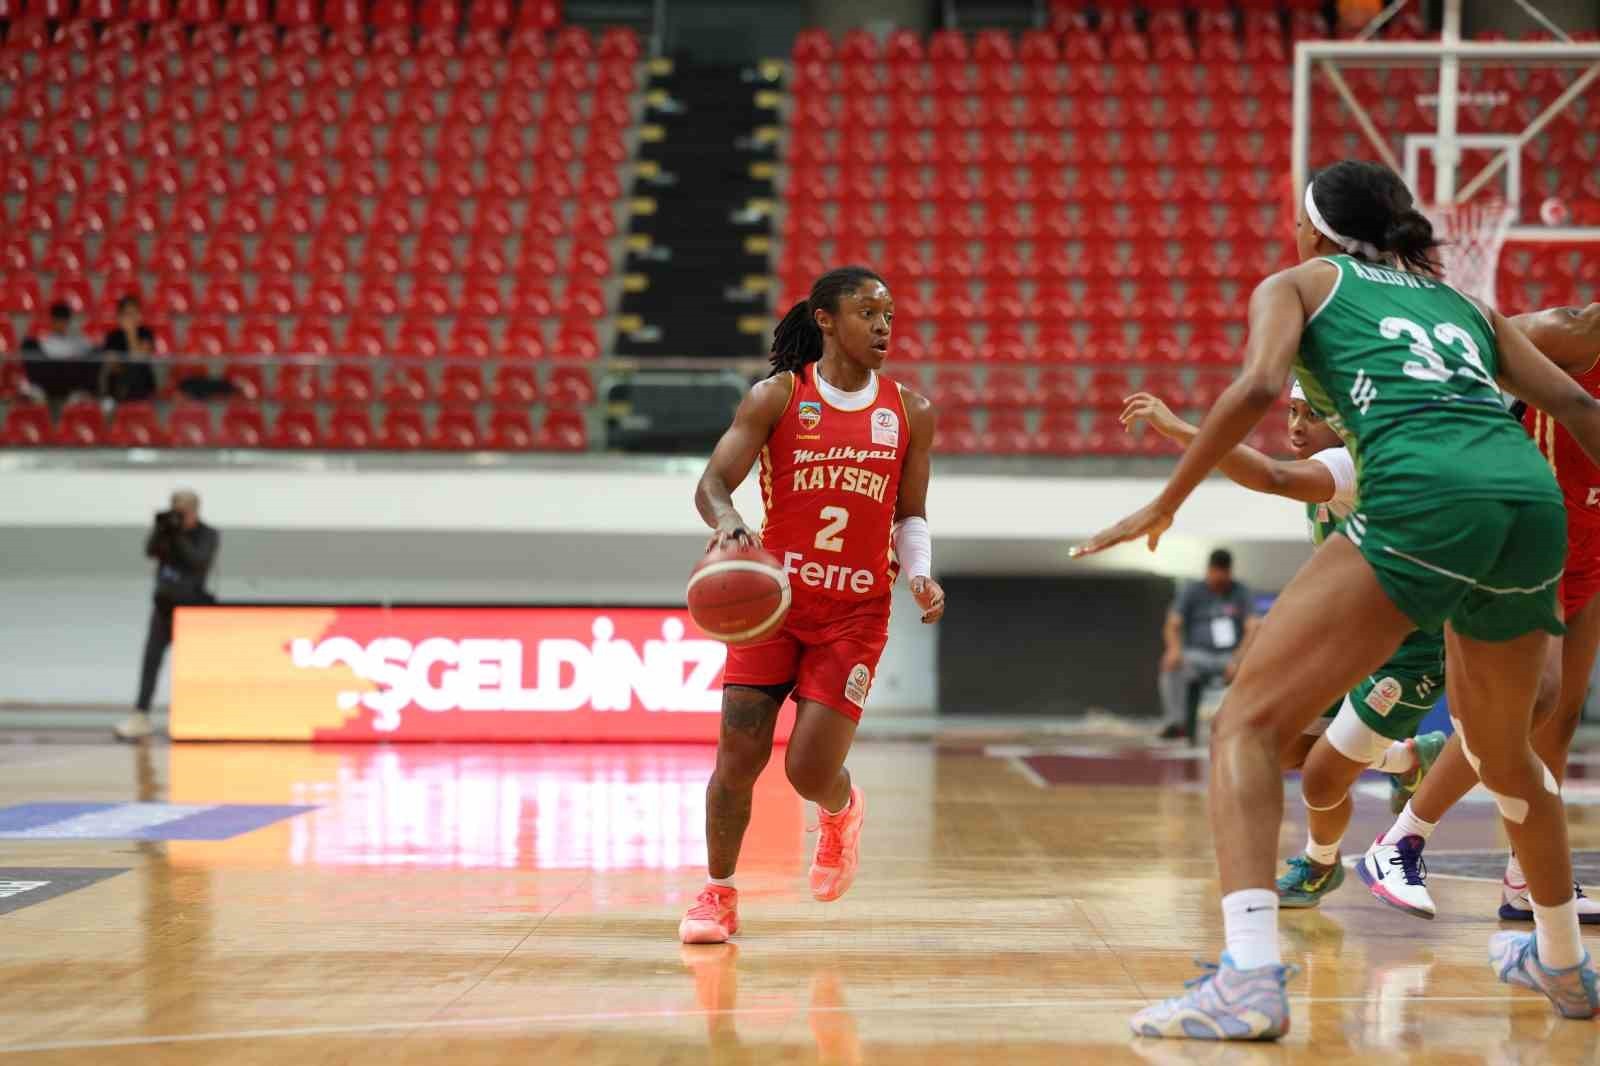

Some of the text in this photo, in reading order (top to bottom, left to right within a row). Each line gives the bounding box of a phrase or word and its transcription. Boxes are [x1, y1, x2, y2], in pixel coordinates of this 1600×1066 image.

[1378, 316, 1500, 394] 33
[793, 446, 897, 465] Melikgazi
[793, 465, 890, 504] KAYSERİ
[814, 505, 849, 552] 2
[783, 552, 874, 593] Ferre
